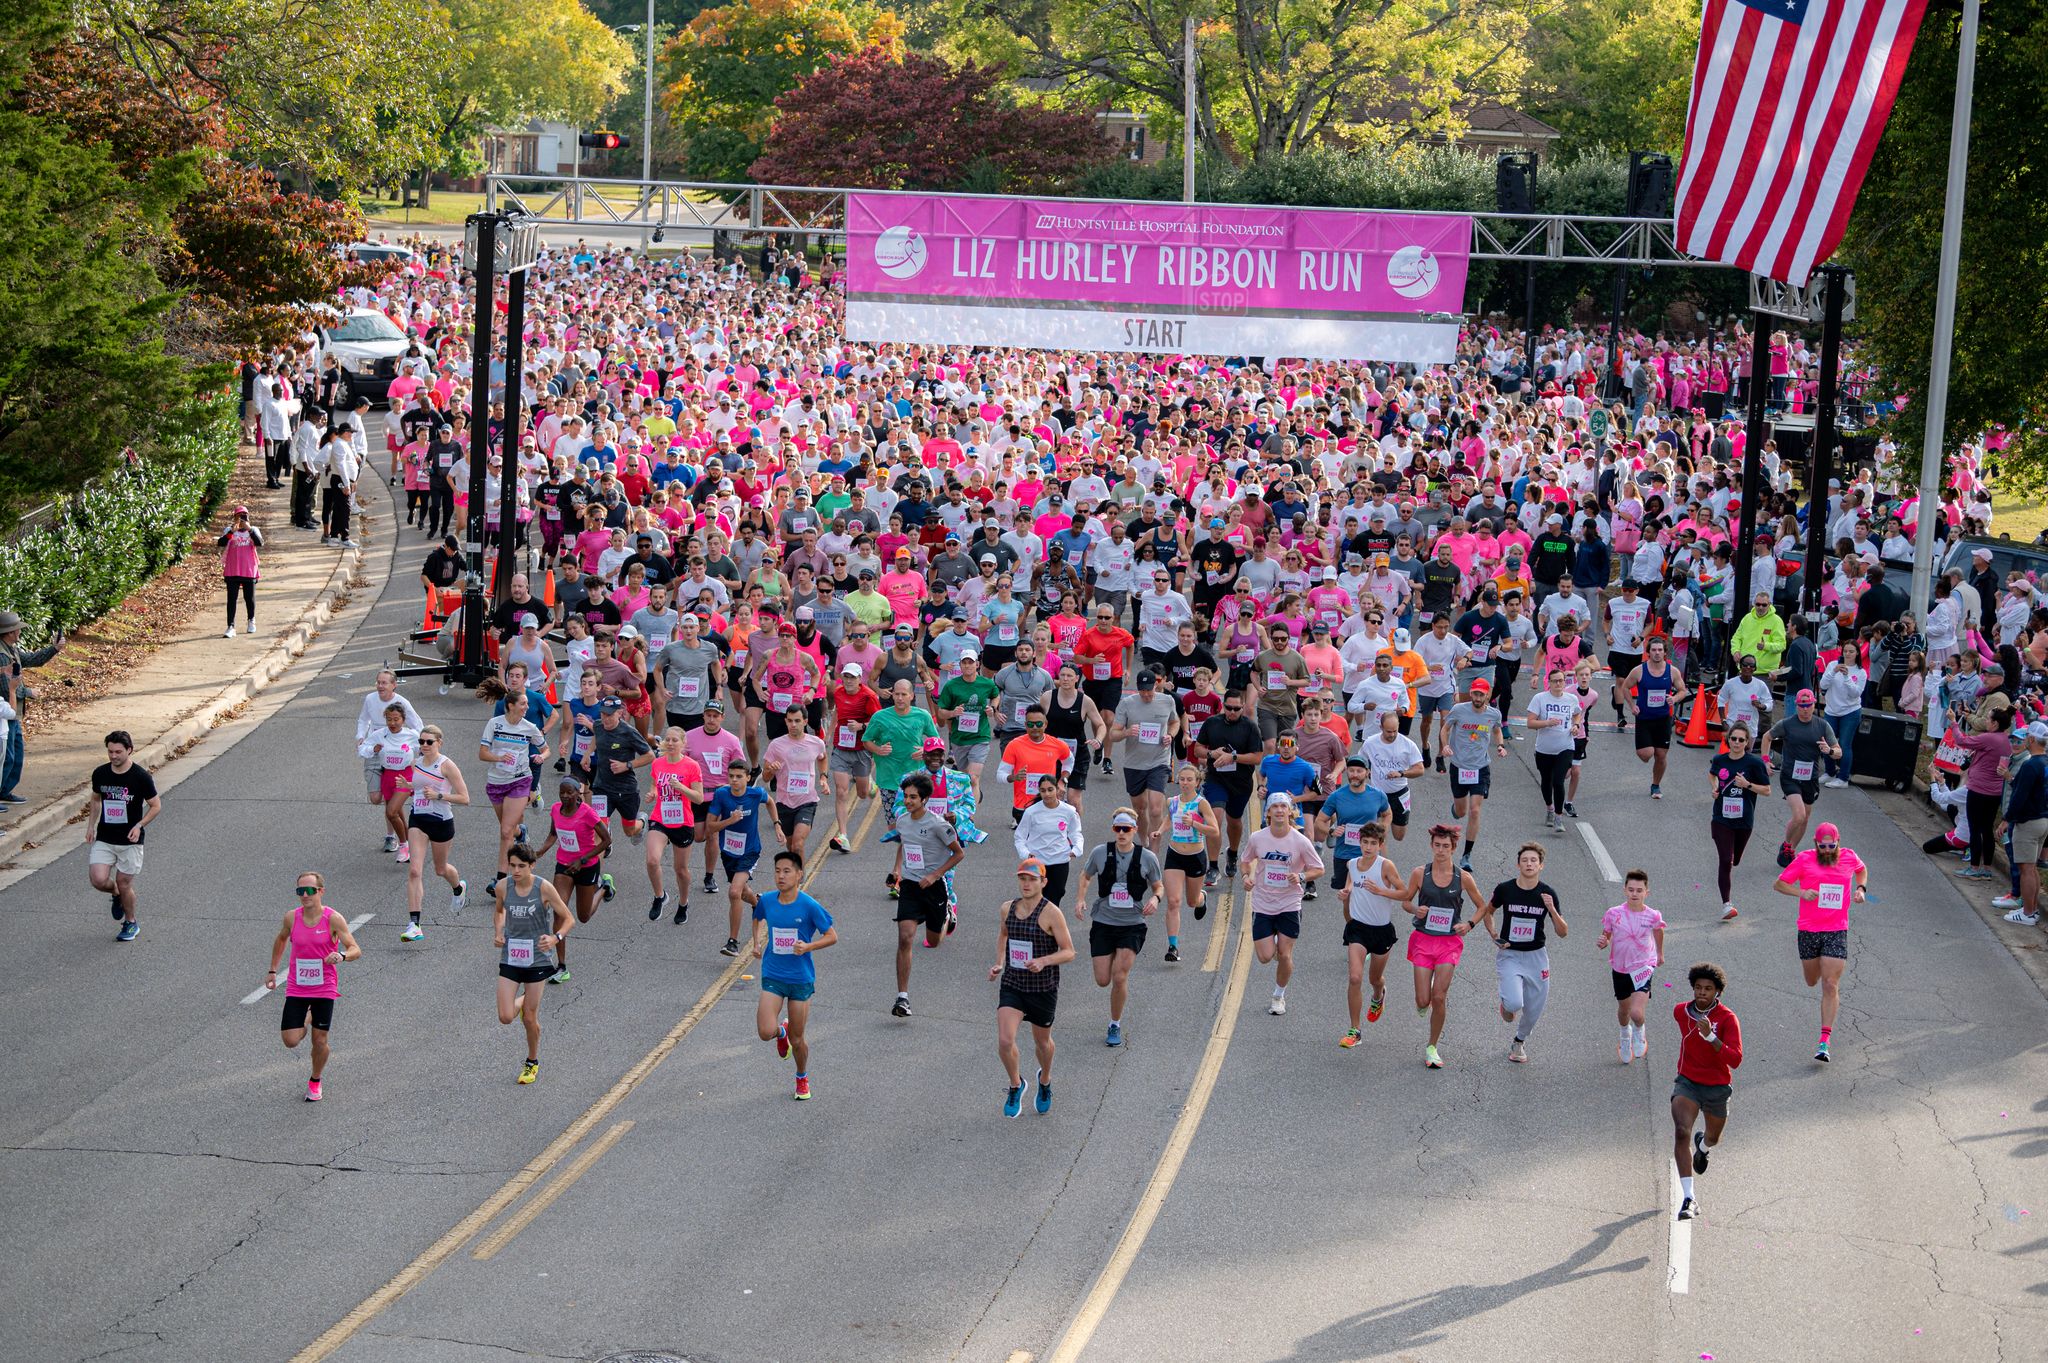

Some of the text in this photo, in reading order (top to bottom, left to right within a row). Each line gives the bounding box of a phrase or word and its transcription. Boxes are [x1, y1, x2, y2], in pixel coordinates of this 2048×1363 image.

[1056, 217, 1284, 236] HUNTSVILLE HOSPITAL FOUNDATION
[953, 238, 1363, 292] LIZ HURLEY RIBBON RUN
[1124, 318, 1187, 348] START
[1592, 423, 1605, 431] 54
[1262, 851, 1290, 862] JETS
[509, 905, 528, 913] FLEET
[1528, 905, 1544, 915] ARMY
[1512, 926, 1533, 936] 4174
[510, 948, 530, 959] 3781
[299, 968, 320, 978] 2783
